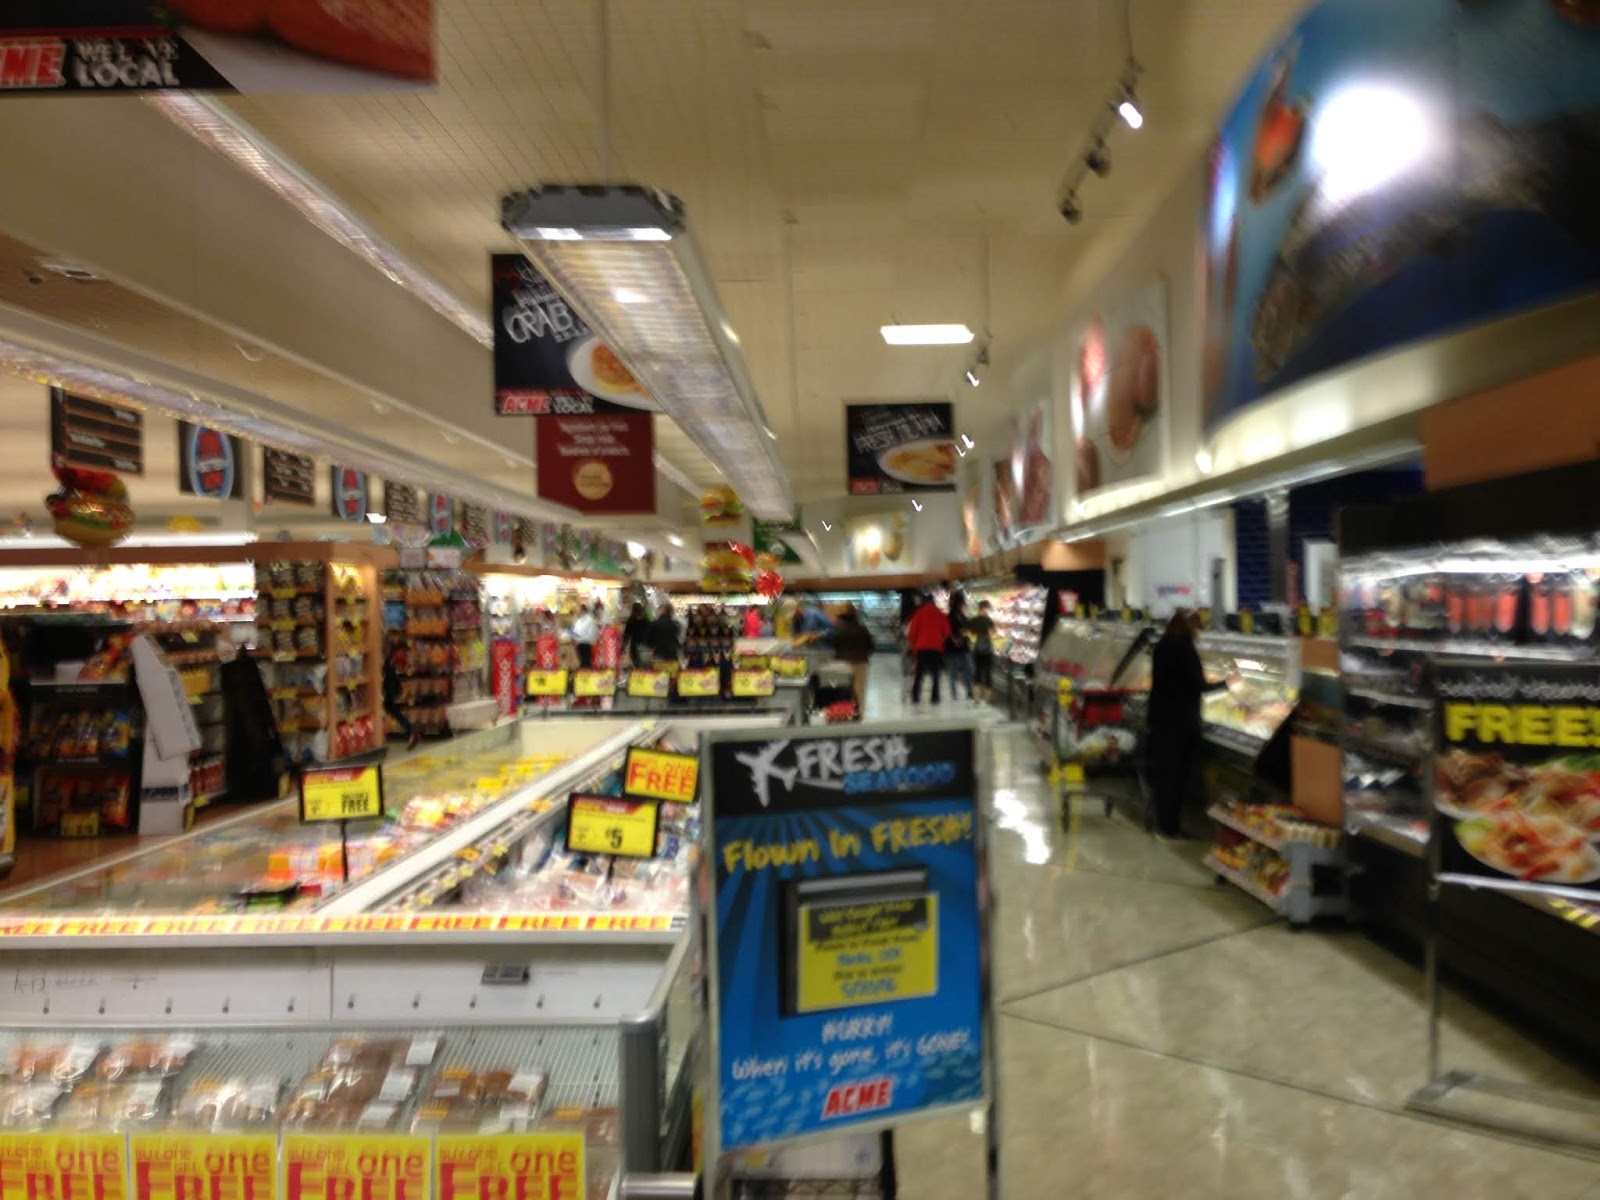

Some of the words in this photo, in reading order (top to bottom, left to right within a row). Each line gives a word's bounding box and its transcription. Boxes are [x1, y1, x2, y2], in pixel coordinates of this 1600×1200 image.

[77, 58, 180, 87] LOCAL
[796, 736, 910, 780] FRESH
[629, 762, 694, 794] FREE
[843, 763, 956, 794] SEAFOOD
[341, 799, 369, 814] FREE
[722, 838, 820, 873] Flown
[828, 829, 861, 858] In
[870, 812, 973, 853] FRESH!
[732, 1055, 788, 1081] When
[823, 1079, 893, 1119] ACME
[56, 1149, 119, 1172] one
[205, 1151, 270, 1175] one
[357, 1152, 424, 1176] one
[510, 1151, 577, 1175] one
